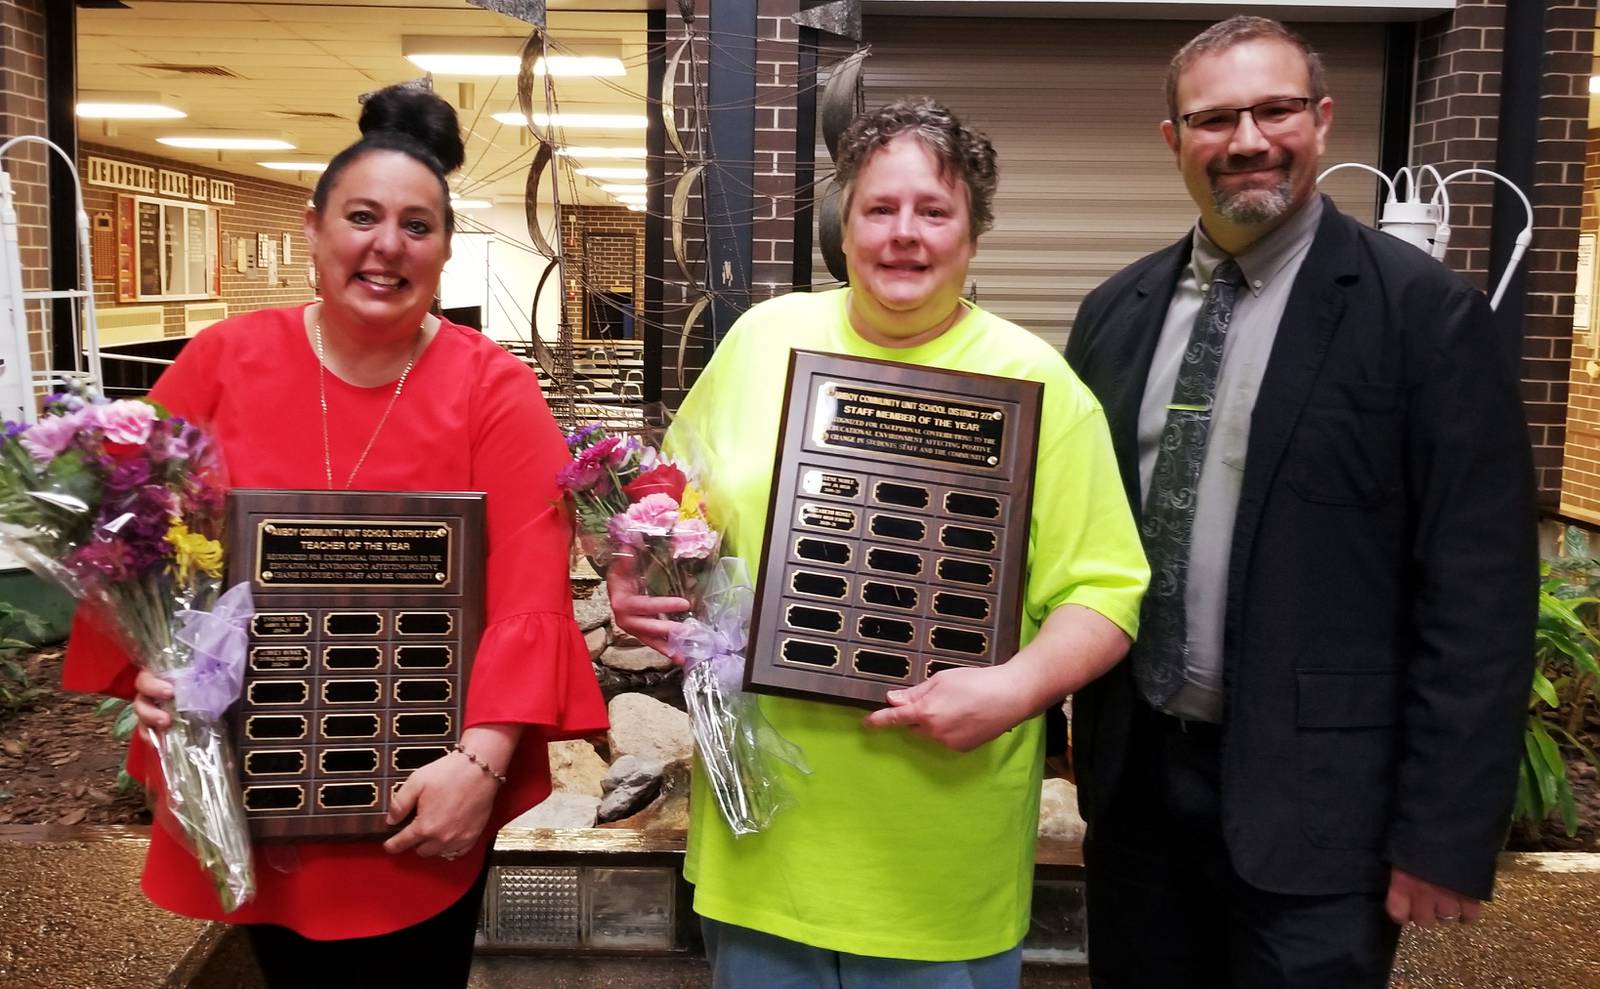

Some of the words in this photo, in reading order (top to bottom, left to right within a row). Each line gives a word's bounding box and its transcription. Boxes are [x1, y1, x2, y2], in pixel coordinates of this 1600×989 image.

[92, 160, 155, 189] ACADEMIC
[162, 173, 187, 194] HALL
[212, 182, 235, 200] FAME
[843, 405, 875, 416] STAFF
[875, 410, 916, 423] MEMBER
[918, 416, 932, 425] OF
[933, 418, 953, 428] THE
[954, 421, 980, 432] YEAR
[859, 394, 901, 407] COMMUNITY
[901, 400, 918, 410] UNIT
[918, 403, 946, 414] SCHOOL
[948, 408, 979, 418] DISTRICT
[979, 412, 993, 421] 272
[830, 416, 865, 426] COGNIZED
[880, 423, 921, 435] EXCEPTIONAL
[830, 434, 856, 442] CHANGE
[865, 439, 898, 449] STUDENTS
[948, 450, 986, 462] COMMUNITY
[875, 431, 923, 443] ENVIRONMENT
[926, 439, 960, 449] AFFECTING
[961, 444, 992, 453] POSITIVE
[299, 528, 343, 537] COMMUNITY
[344, 528, 361, 537] UNIT
[362, 529, 392, 538] SCHOOL
[392, 530, 424, 538] DISTRICT
[300, 541, 346, 550] TEACHER
[348, 541, 362, 550] OF
[363, 542, 383, 550] THE
[385, 542, 410, 551] YEAR
